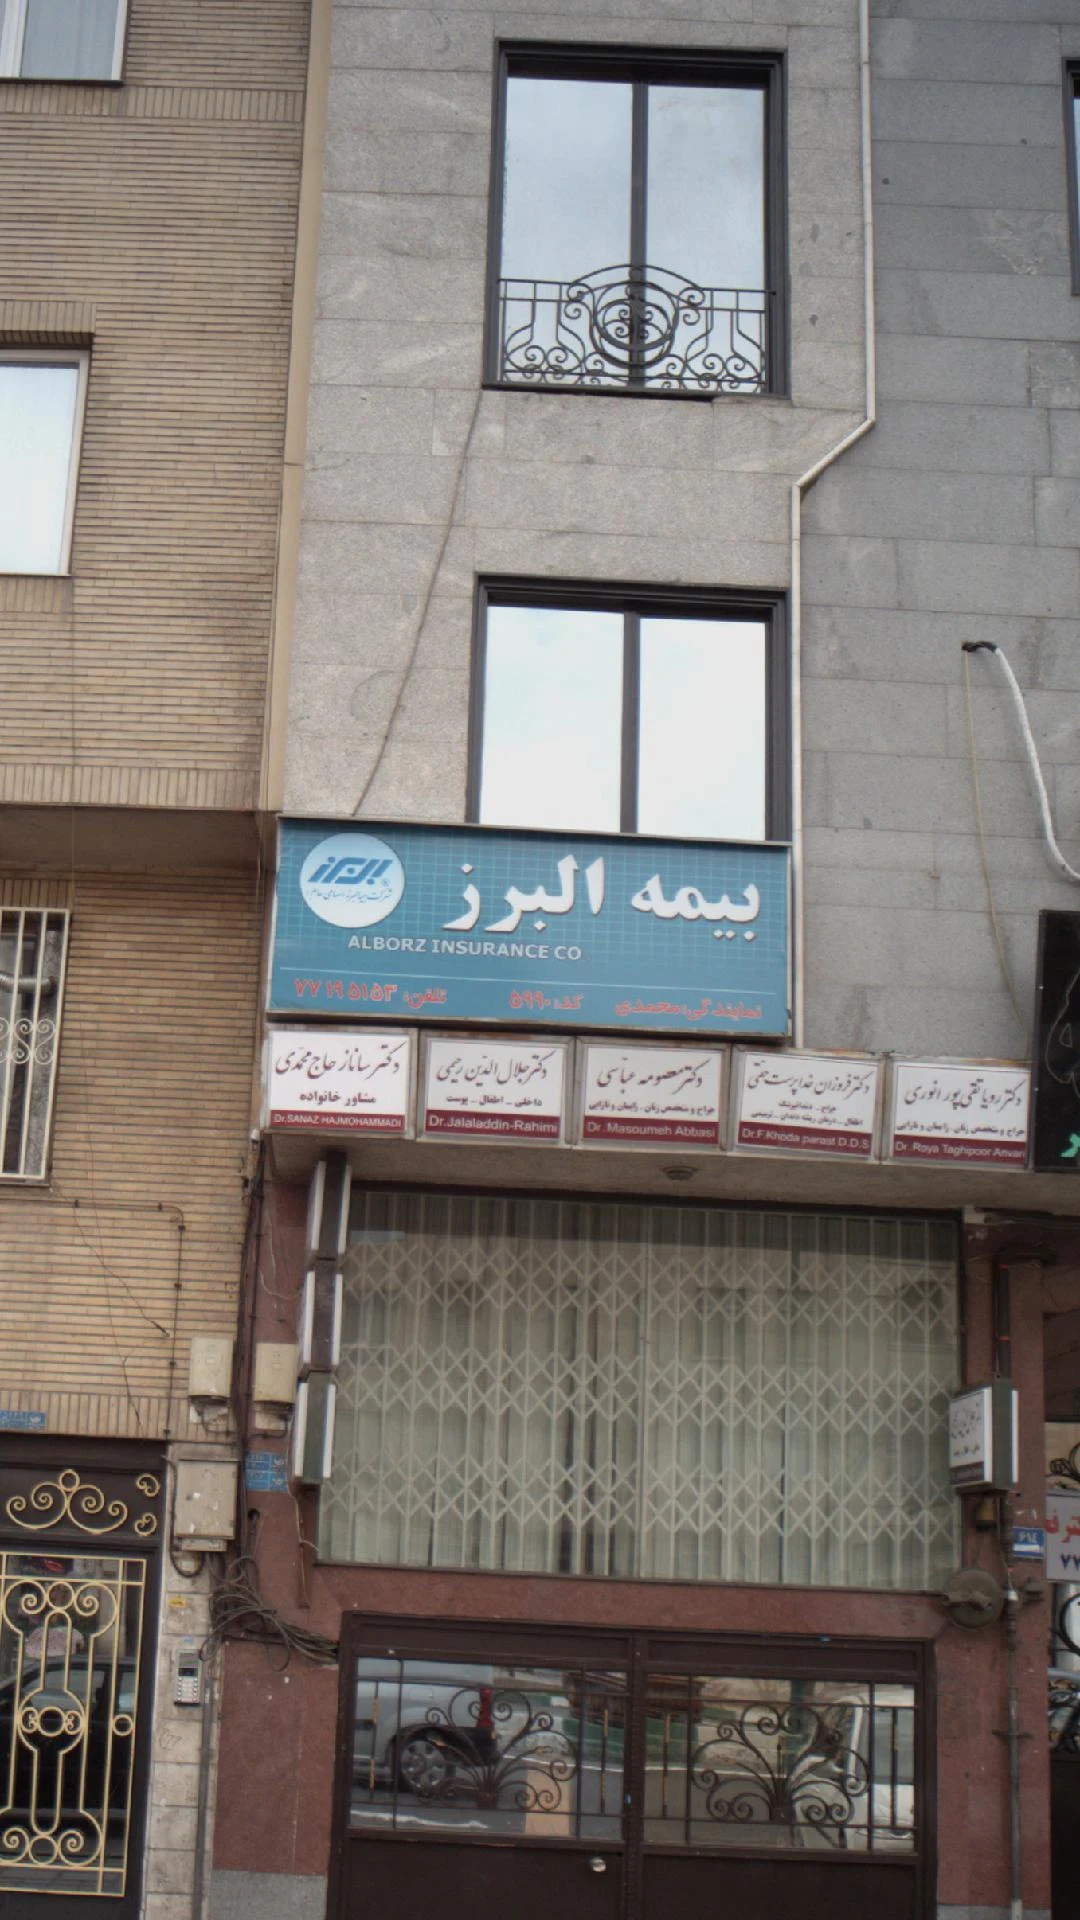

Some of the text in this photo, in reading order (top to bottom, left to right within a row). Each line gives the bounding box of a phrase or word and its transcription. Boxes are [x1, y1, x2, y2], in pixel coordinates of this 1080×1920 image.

[441, 854, 761, 940] بیمه البرز
[347, 934, 582, 961] ALBORZ INSURANCE CO
[307, 1051, 337, 1080] حاج
[338, 1047, 370, 1073] ساناز
[365, 1040, 407, 1081] دکتر
[436, 1057, 464, 1084] رحیمی
[496, 1060, 530, 1085] جلال
[520, 1049, 557, 1086] دکتر
[637, 1066, 683, 1087] معصومه
[671, 1057, 712, 1095] دکتر
[843, 1070, 876, 1101] دکتر
[299, 1090, 377, 1107] مشاور خانواده
[996, 1079, 1027, 1113] دکتر
[321, 1114, 403, 1129] HAJMOHAMMADI
[607, 1121, 673, 1136] Masoumeh
[674, 1125, 716, 1138] Abbasi
[912, 1141, 939, 1155] Roya
